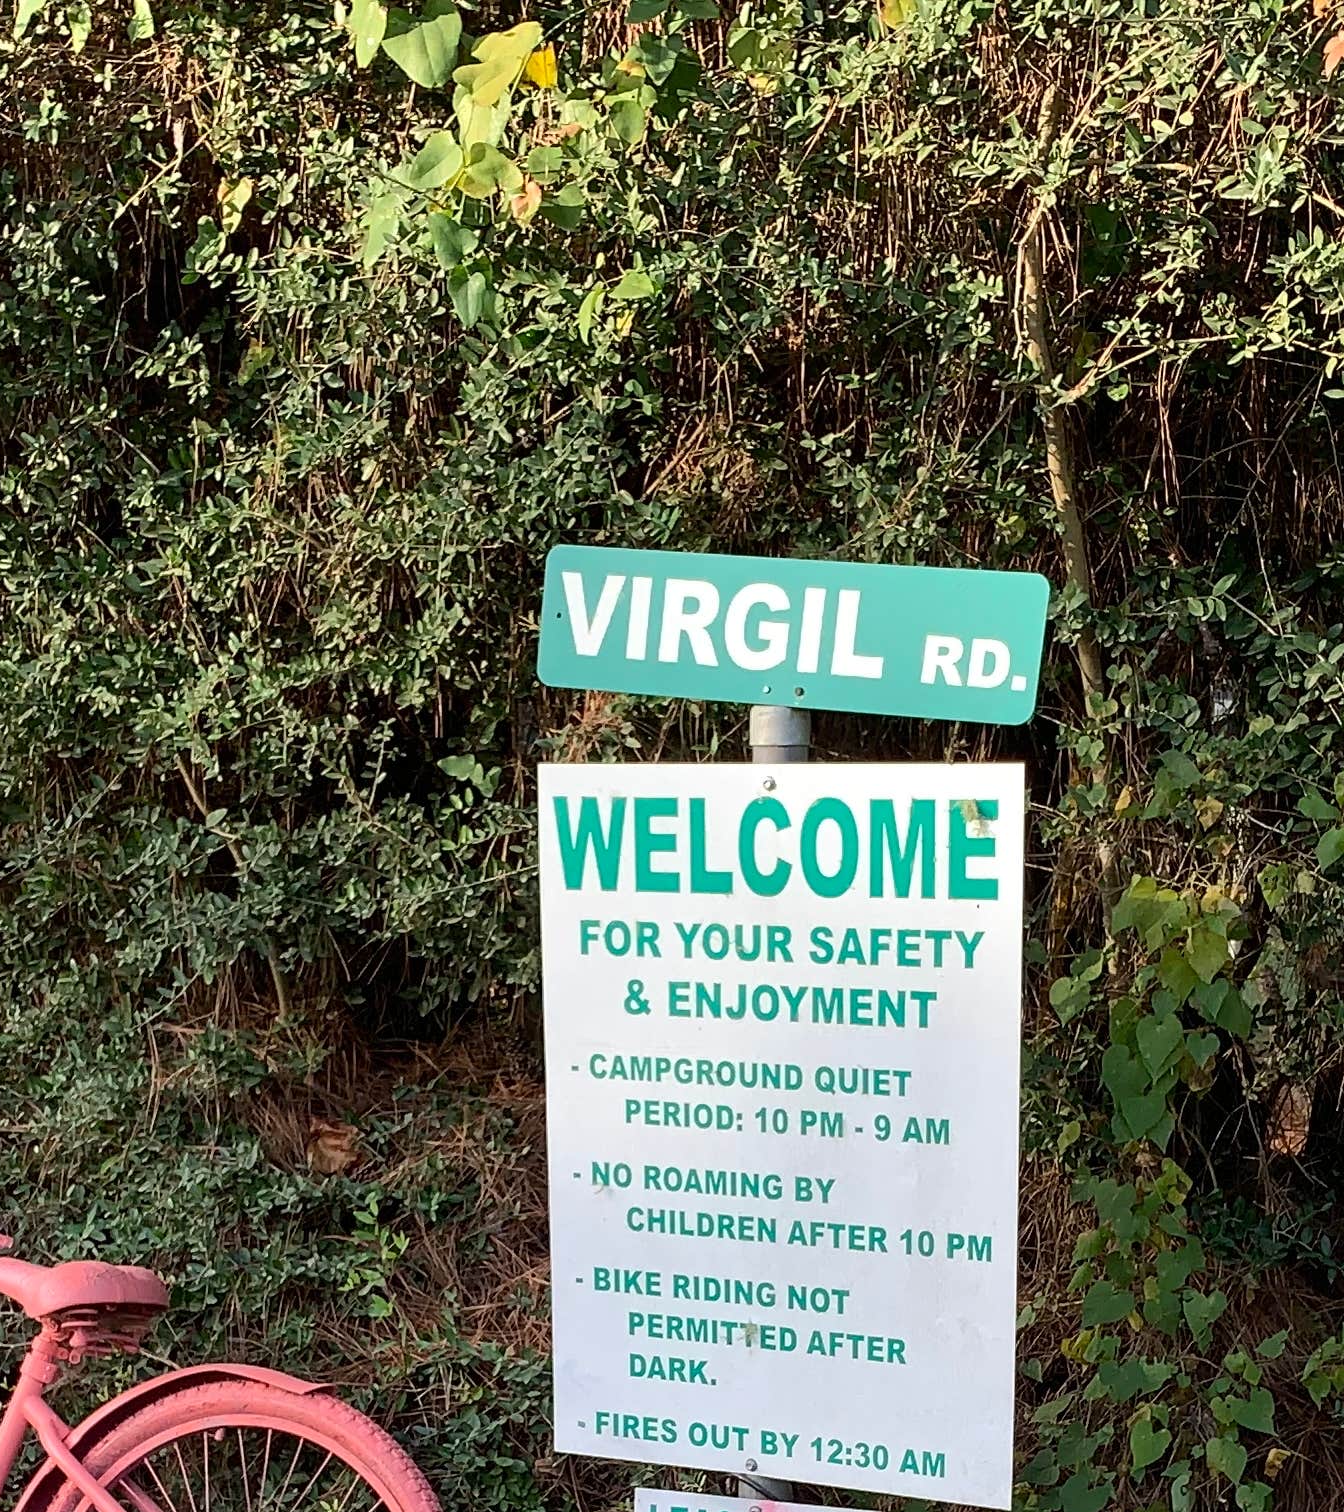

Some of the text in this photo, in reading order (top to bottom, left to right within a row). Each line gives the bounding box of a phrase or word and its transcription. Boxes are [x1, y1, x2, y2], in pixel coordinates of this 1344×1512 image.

[562, 572, 1026, 690] VIRGIL RD.
[553, 796, 998, 900] WELCOME
[581, 920, 984, 968] FOR YOUR SAFETY
[624, 979, 937, 1028] & ENJOYMENT
[590, 1054, 802, 1090] CAMPGROUND
[815, 1066, 911, 1096] QUIET
[626, 1100, 742, 1131] PERIOD:
[755, 1108, 788, 1134] 10
[801, 1110, 843, 1137] PM
[875, 1115, 891, 1141] 9
[903, 1117, 949, 1145] AM
[592, 1162, 632, 1188] NO
[644, 1166, 782, 1200] ROAMING
[795, 1177, 835, 1203] BY
[627, 1207, 992, 1262] CHILDREN AFTER 10 PM
[594, 1267, 661, 1296] BIKE
[673, 1275, 776, 1307] RIDING
[788, 1285, 849, 1314] NOT
[629, 1312, 906, 1364] PERMITTED AFTER
[630, 1353, 716, 1385] DARK.
[596, 1412, 677, 1443] FIRES
[689, 1422, 749, 1451] OUT
[761, 1430, 799, 1457] BY
[811, 1437, 888, 1470] 12:30
[899, 1449, 945, 1478] AM
